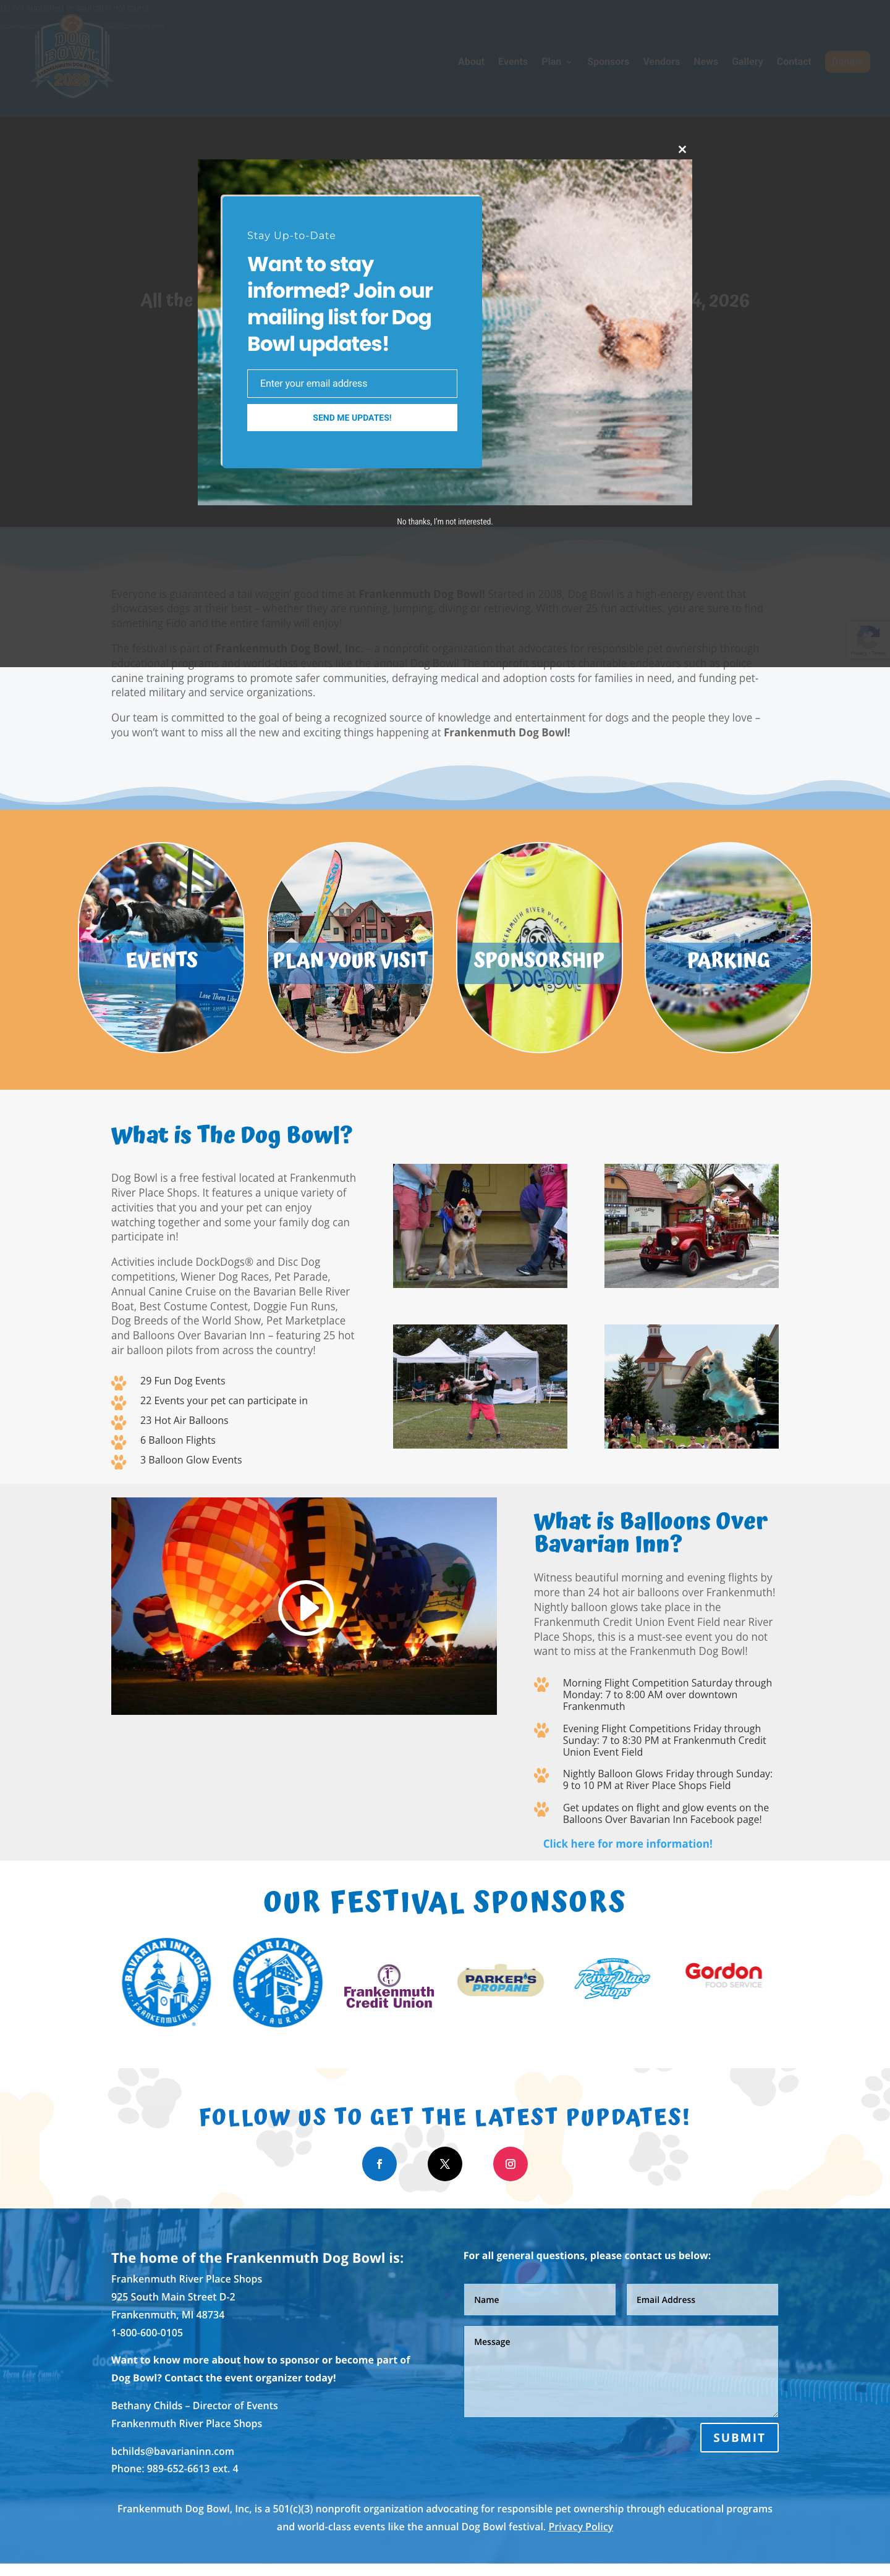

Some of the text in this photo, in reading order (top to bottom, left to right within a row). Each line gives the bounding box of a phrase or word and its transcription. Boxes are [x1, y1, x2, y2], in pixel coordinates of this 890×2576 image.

[55, 32, 89, 46] DOG
[44, 46, 99, 64] BOWL
[588, 58, 629, 67] Sponsors
[732, 57, 762, 67] Gallery
[248, 232, 335, 241] Stay Up-to-Date
[248, 257, 374, 277] Want to stay
[248, 281, 433, 298] informed? Join our
[141, 292, 192, 308] All the
[248, 308, 431, 330] mailing list for Dog
[248, 335, 388, 356] Bowl updates!
[286, 381, 304, 389] your
[409, 518, 431, 526] thanks,
[112, 688, 315, 699] related military and service organizations.
[127, 951, 197, 969] EVENTS
[274, 951, 428, 969] PLAN YOUR VISIT
[474, 952, 604, 968] SPONSORSHIP
[689, 952, 769, 969] PARKING
[199, 991, 211, 1000] Love
[213, 993, 226, 1001] Them
[111, 1124, 352, 1148] What is The Dog Bowl?
[187, 1399, 208, 1407] your
[211, 1397, 226, 1407] pet
[248, 1396, 296, 1407] participate
[534, 1512, 768, 1531] What is Balloons Over
[535, 1534, 682, 1553] Bavarian Inn?
[544, 1839, 568, 1848] Click
[572, 1839, 595, 1848] here
[598, 1839, 613, 1848] for
[647, 1839, 712, 1848] information!
[264, 1889, 625, 1914] OUR FESTIVAL SPONSORS
[125, 1940, 208, 1982] BAVARIAN INN LODGE
[238, 1940, 319, 1973] BAVARIAN INN
[576, 1969, 650, 1988] River Place
[685, 1963, 762, 1979] Gordon
[344, 1985, 434, 1997] Frankenmuth
[473, 1984, 529, 1992] PROPANE
[584, 1984, 632, 1999] Shops
[346, 1998, 432, 2008] Credit Union
[243, 2001, 312, 2024] RESTAURANT
[200, 2107, 689, 2127] FOLLOW US TO GET THE LATEST PUPDATES!
[112, 2252, 403, 2266] The home of the Frankenmuth Dog Bowl is:
[112, 2311, 178, 2320] Frankenmuth,
[475, 2339, 510, 2347] Message
[714, 2433, 764, 2442] SUBMIT
[112, 2448, 234, 2456] bchilds@bavarianinn.com
[549, 2523, 613, 2532] Privacy Policy
